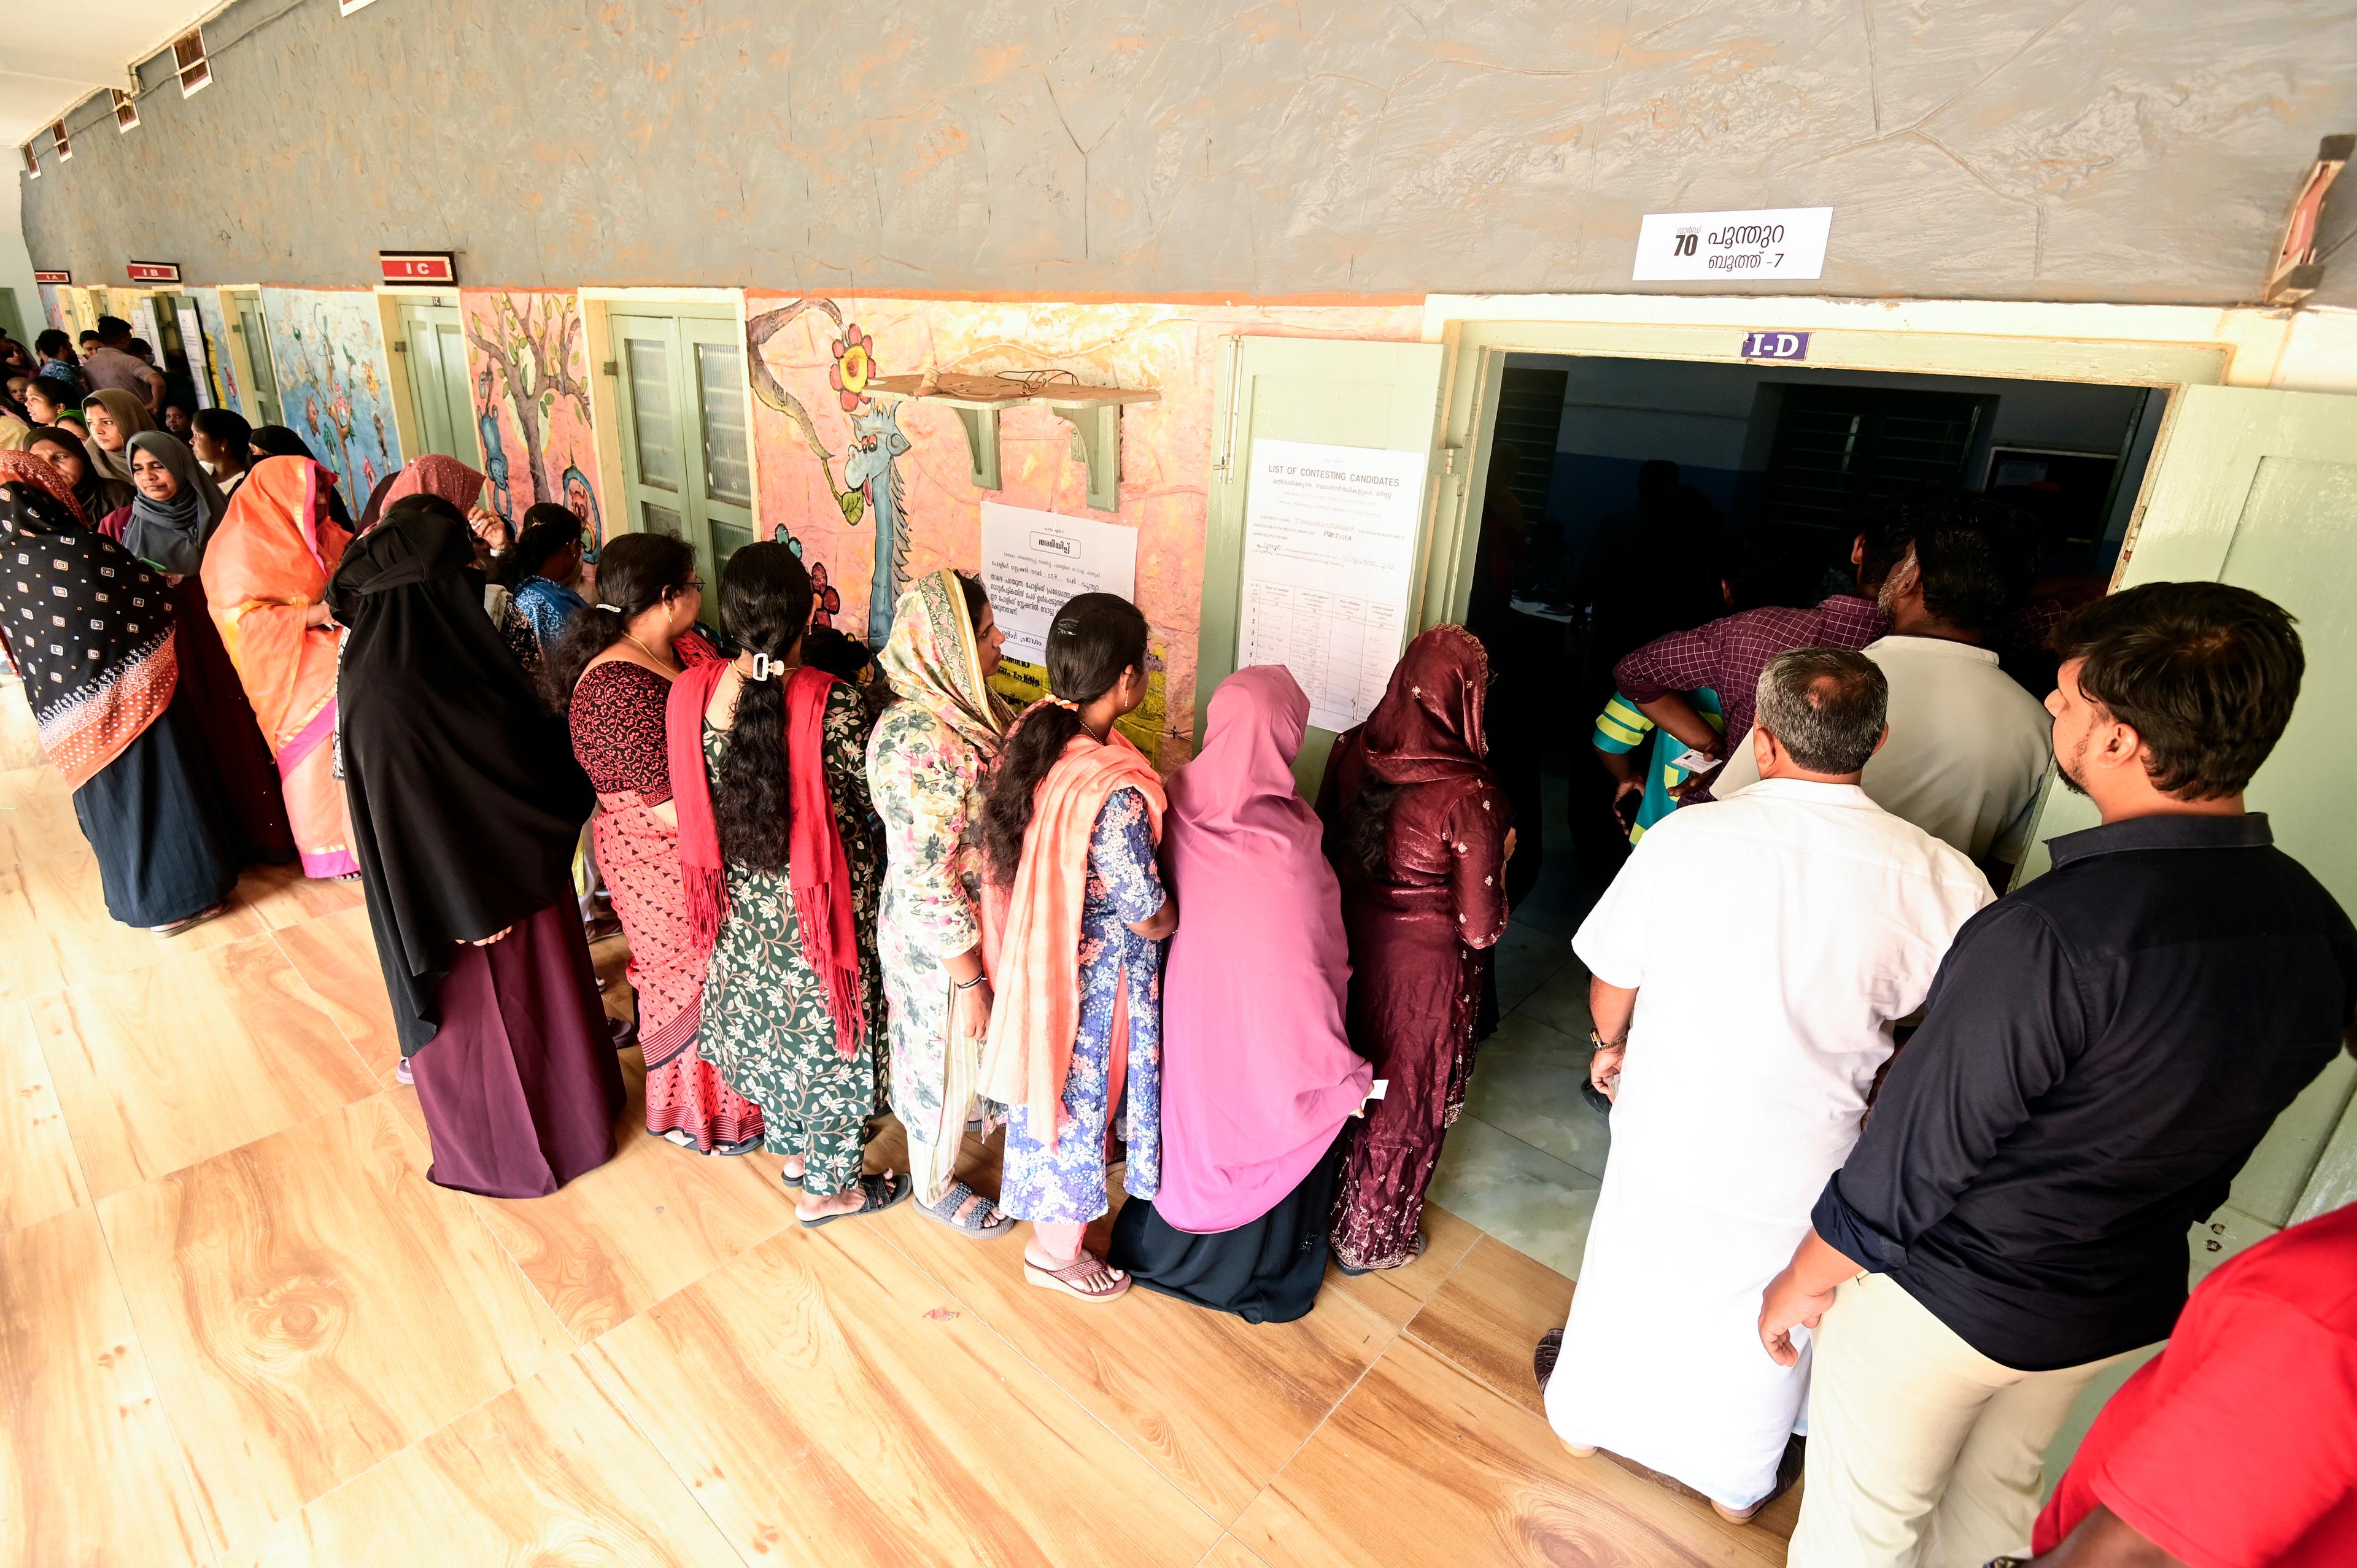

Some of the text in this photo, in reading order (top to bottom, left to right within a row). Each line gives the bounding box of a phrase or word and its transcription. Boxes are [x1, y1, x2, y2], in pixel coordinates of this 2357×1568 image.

[1674, 234, 1698, 256] 70
[1708, 225, 1784, 249] പൂന്തുറ
[1708, 251, 1765, 272] ബൂത്ത്
[1750, 334, 1799, 357] I-D
[1269, 465, 1283, 473] LIST
[1300, 468, 1346, 481] CONTESTING
[1350, 474, 1399, 487] CANDIDATES
[1039, 539, 1070, 554] അറിയിപ്പ്
